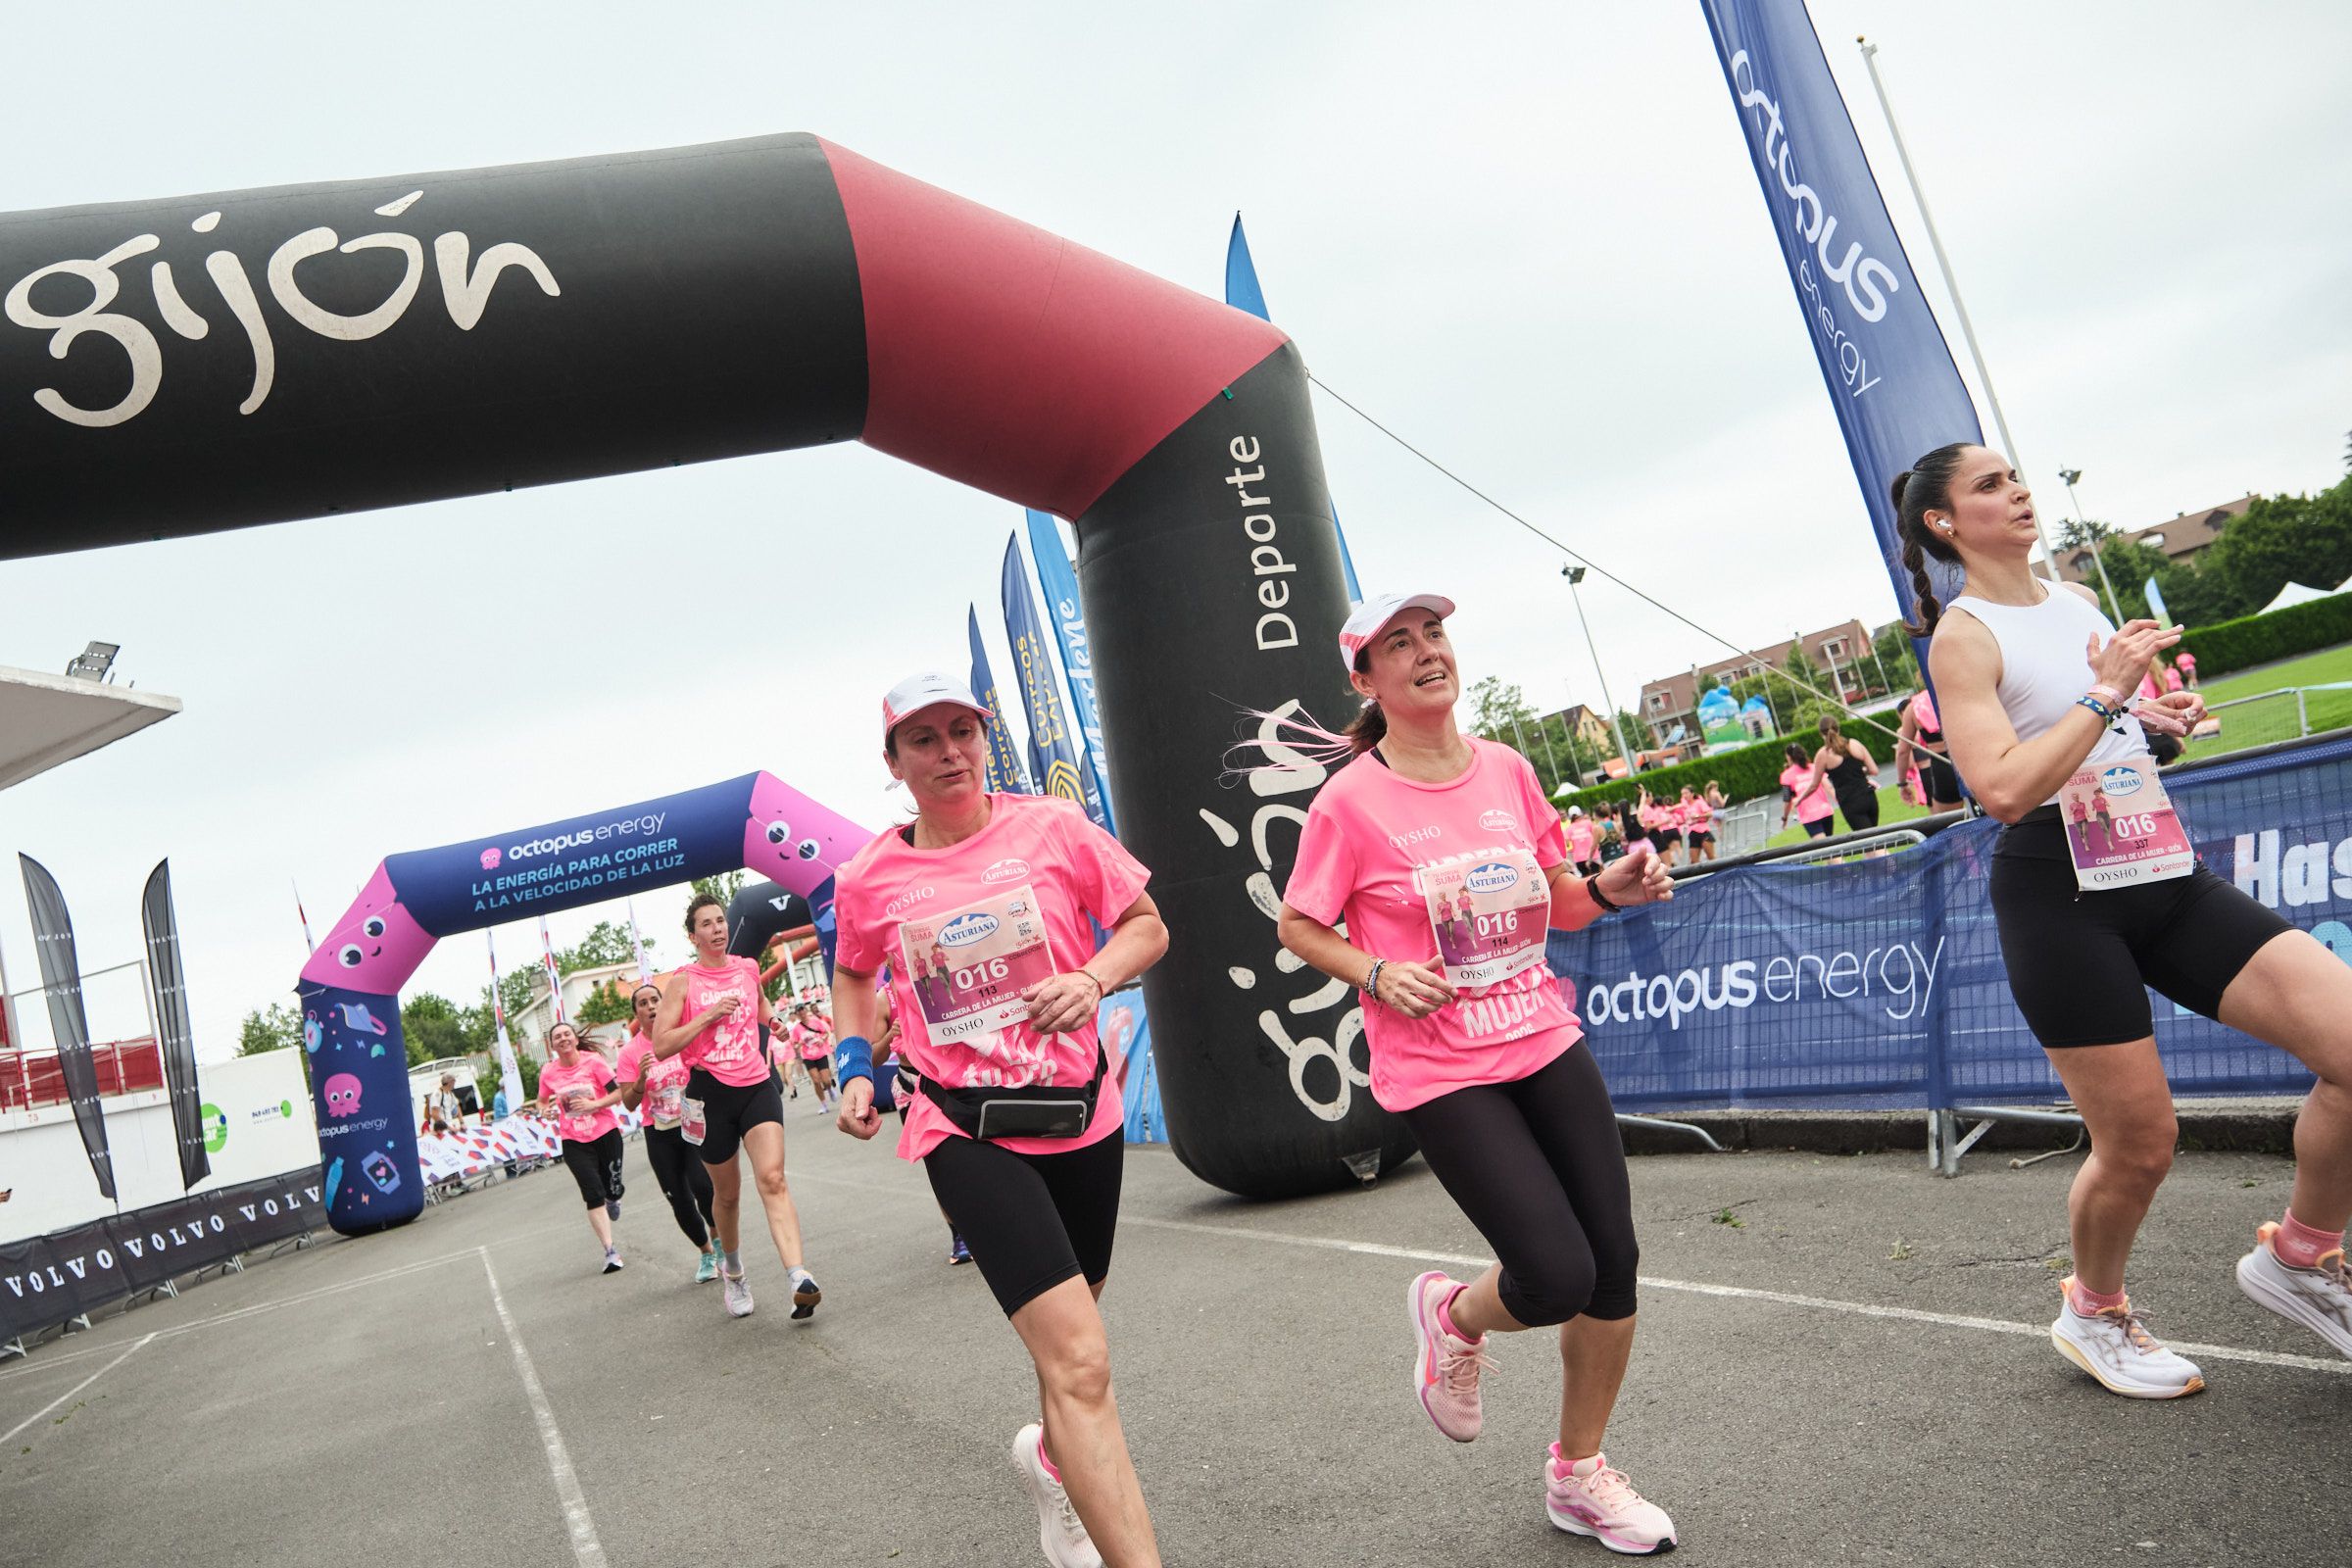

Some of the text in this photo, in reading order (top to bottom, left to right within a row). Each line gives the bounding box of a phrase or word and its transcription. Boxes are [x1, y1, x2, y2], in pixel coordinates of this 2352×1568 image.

[1732, 49, 1899, 398] octopus energy
[4, 190, 561, 427] gijón
[1225, 435, 1299, 651] Deporte
[2069, 775, 2097, 787] SUMA
[2104, 777, 2141, 791] ASTURIANA
[509, 811, 665, 860] octopus energy
[1389, 825, 1442, 849] OYSHO
[2115, 813, 2157, 839] 016
[2134, 839, 2149, 850] 337
[472, 838, 678, 896] LA ENERGÍA PARA CORRER
[2095, 854, 2128, 865] CARRERA
[2128, 852, 2137, 860] DE
[2137, 850, 2146, 859] LA
[474, 854, 685, 911] A LA VELOCIDAD DE LA LUZ
[985, 866, 1028, 883] ASTURIANA
[1435, 874, 1462, 886] SUMA
[1469, 874, 1516, 889] ASTURIANA
[2093, 867, 2137, 883] OYSHO
[886, 887, 935, 917] OYSHO
[944, 919, 996, 944] ASTURIANA
[1477, 910, 1518, 937] 016
[910, 932, 934, 943] SUMA
[1492, 936, 1508, 948] 114
[956, 957, 1009, 990] 016
[1460, 967, 1494, 980] OYSHO
[1587, 935, 1945, 1030] octopus energy
[978, 985, 998, 998] 113
[941, 1006, 971, 1020] CARRERA
[971, 1002, 981, 1012] DE
[981, 1000, 992, 1010] LA
[992, 992, 1015, 1006] MUJER
[1463, 990, 1545, 1039] MUJER
[942, 1017, 984, 1037] OYSHO
[648, 1058, 684, 1079] ARRERA
[349, 1118, 389, 1133] energy
[239, 1186, 320, 1223] VOLV
[124, 1214, 224, 1258] VOLVO
[5, 1249, 114, 1298] VOLVO
